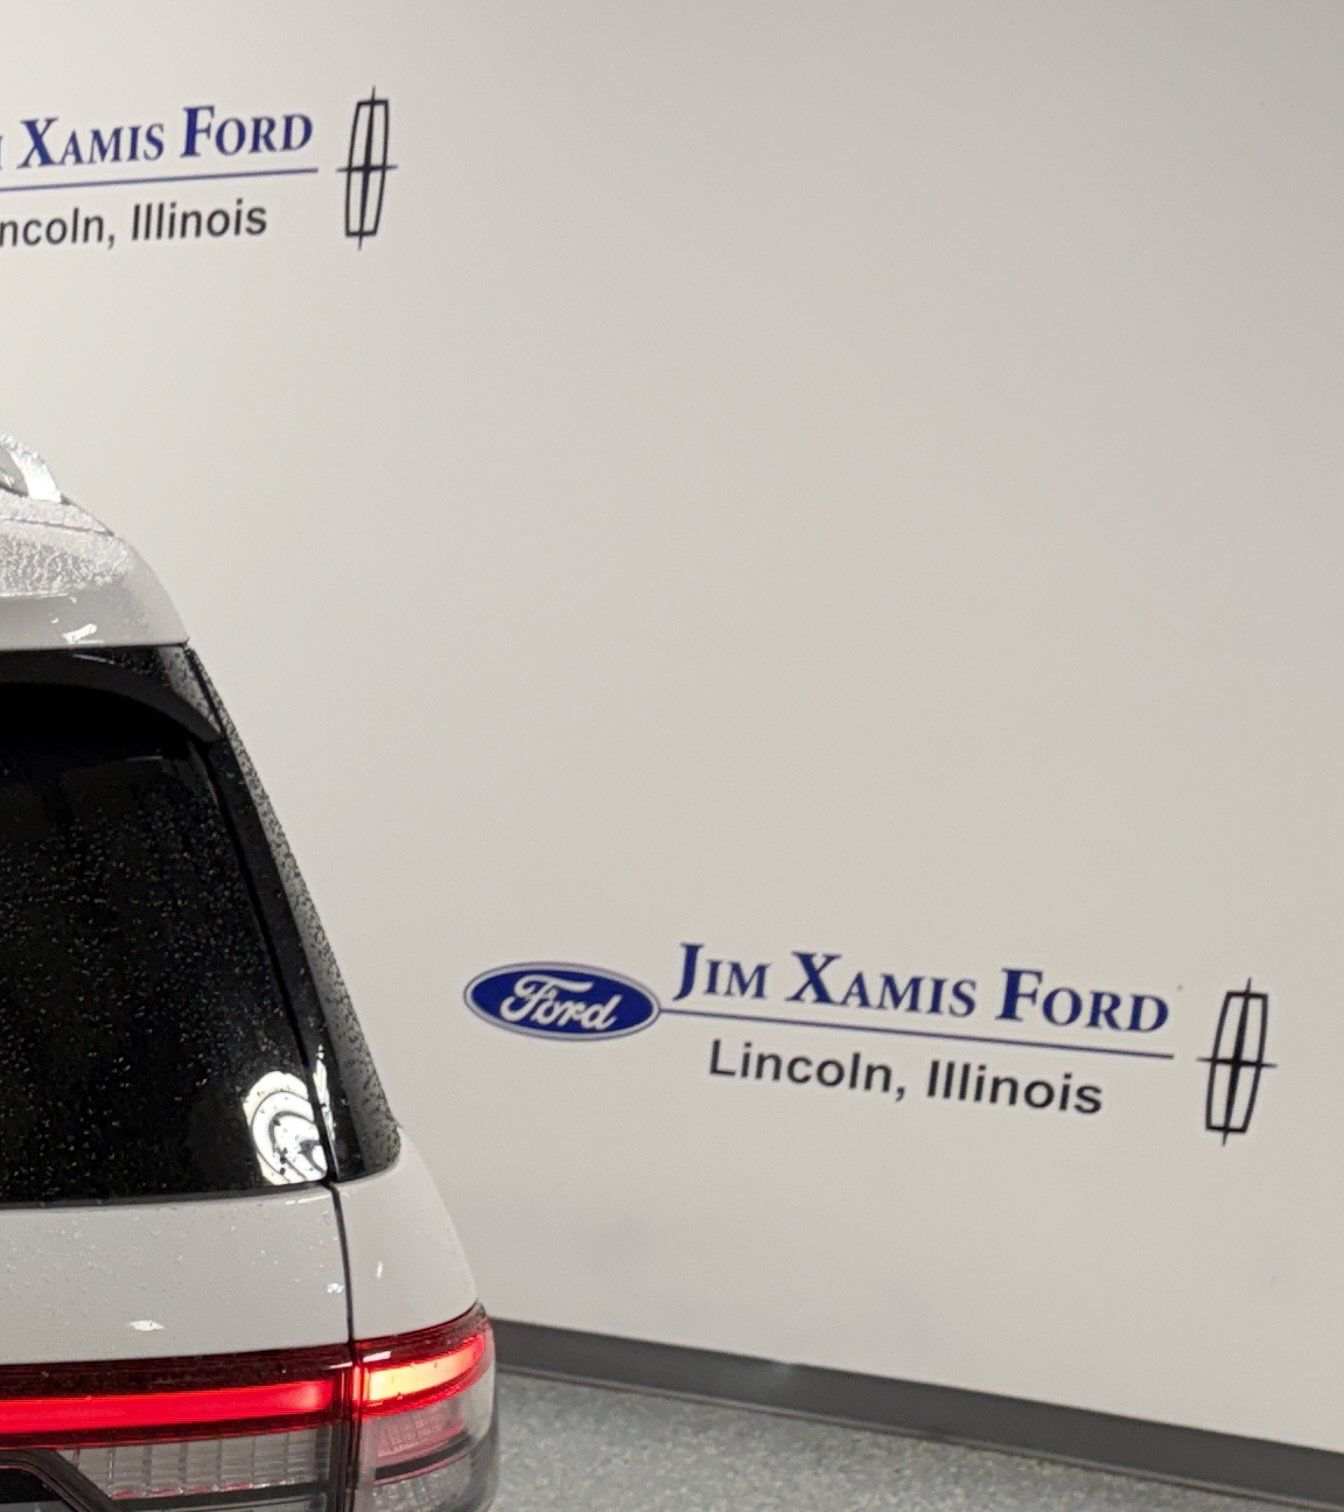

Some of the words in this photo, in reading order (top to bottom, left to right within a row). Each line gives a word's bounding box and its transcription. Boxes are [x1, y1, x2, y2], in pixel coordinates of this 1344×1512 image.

[17, 117, 164, 169] XAMIS
[181, 105, 313, 157] FORD
[132, 200, 267, 239] Illinois
[500, 974, 618, 1030] Ford
[671, 942, 771, 1001] JIM
[787, 952, 977, 1018] XAMIS
[996, 967, 1171, 1034] FORD
[709, 1038, 906, 1101] Lincoln,
[926, 1060, 1104, 1115] Illinois
